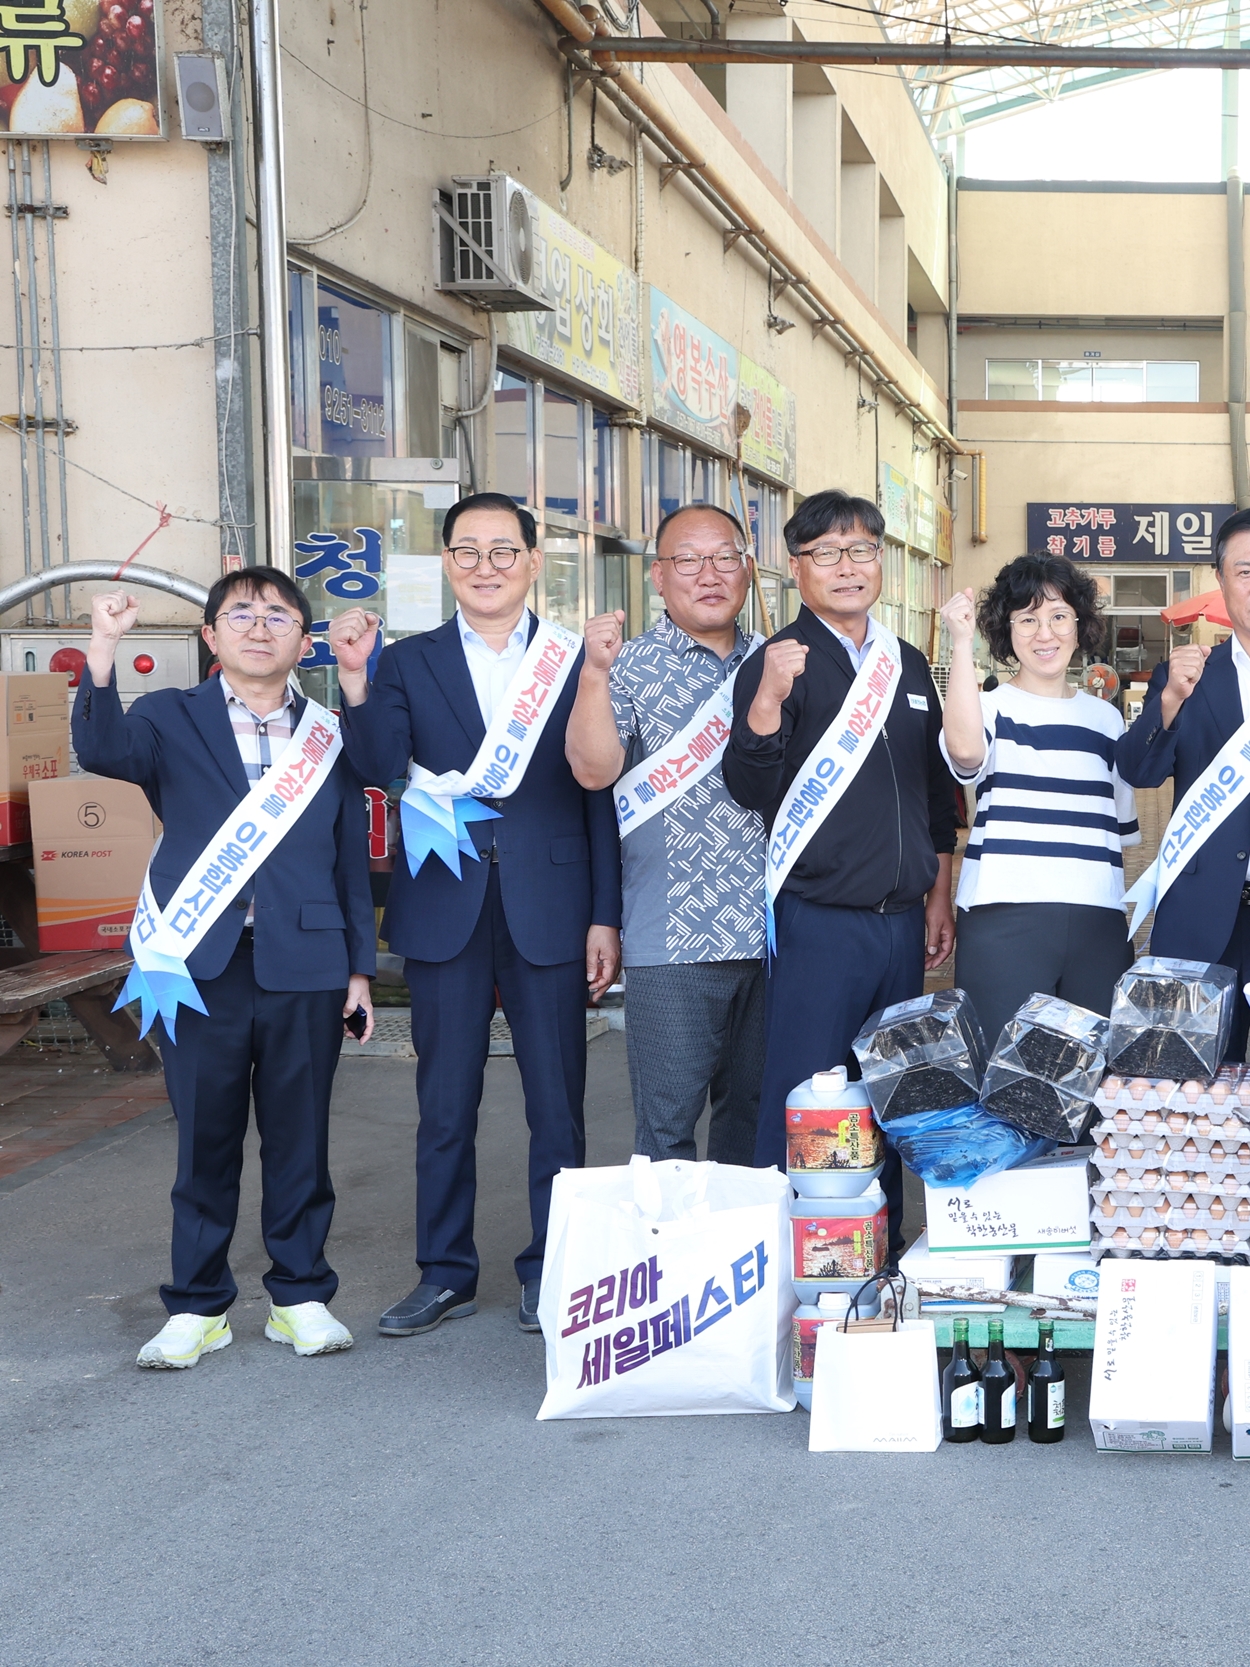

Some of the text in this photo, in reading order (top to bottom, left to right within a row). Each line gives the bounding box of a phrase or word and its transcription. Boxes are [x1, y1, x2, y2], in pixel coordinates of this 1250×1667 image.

[538, 236, 616, 366] 업상회
[673, 322, 729, 422] 영복수산
[324, 385, 387, 438] 9251-3112
[1048, 508, 1116, 529] 고추가루
[1132, 511, 1213, 555] 제일
[506, 638, 568, 742] 전통시장을
[836, 650, 895, 755] 전통시장을
[260, 720, 335, 819] 전통시장을
[463, 744, 520, 798] 이용합
[634, 714, 732, 805] 전통시장을
[769, 757, 845, 871] 이용합시다
[1161, 765, 1245, 869] 이용합시다
[61, 849, 113, 859] KOREA POST
[169, 821, 267, 939] 이용합시다
[848, 1112, 860, 1162] 곰소특산품
[947, 1197, 973, 1211] 서로
[948, 1211, 1002, 1223] 믿을 수 있는
[1037, 1225, 1077, 1236] 새송이버섯
[863, 1220, 874, 1269] 곰소특산품
[561, 1254, 663, 1339] 코리아
[576, 1240, 769, 1390] 세일페스타
[1109, 1309, 1119, 1326] 있는
[1104, 1359, 1117, 1381] 서로
